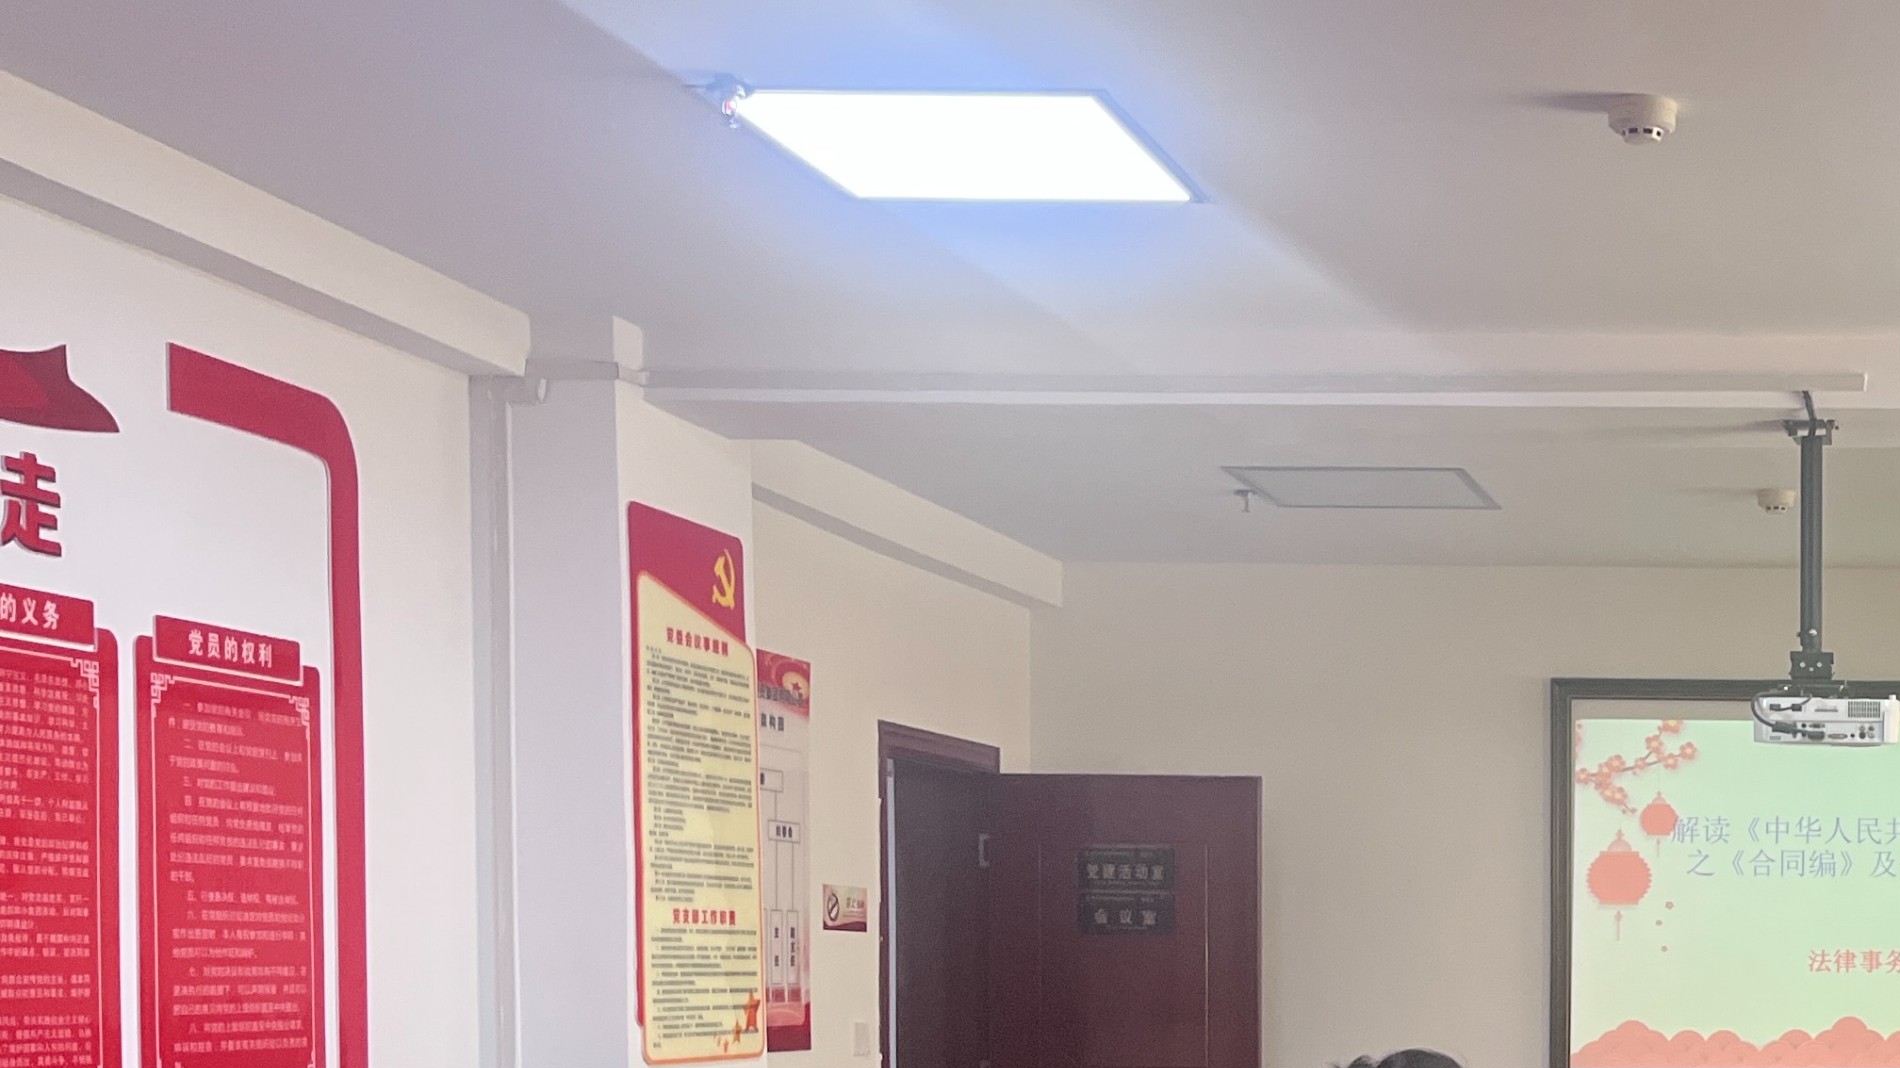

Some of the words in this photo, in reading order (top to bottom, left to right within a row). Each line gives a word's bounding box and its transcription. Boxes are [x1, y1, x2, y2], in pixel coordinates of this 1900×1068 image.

[1, 451, 62, 557] 走
[0, 587, 60, 630] 的义务
[188, 629, 273, 668] 党员的权利
[673, 908, 736, 926] 党支部工作职责
[1094, 908, 1156, 926] 会议室
